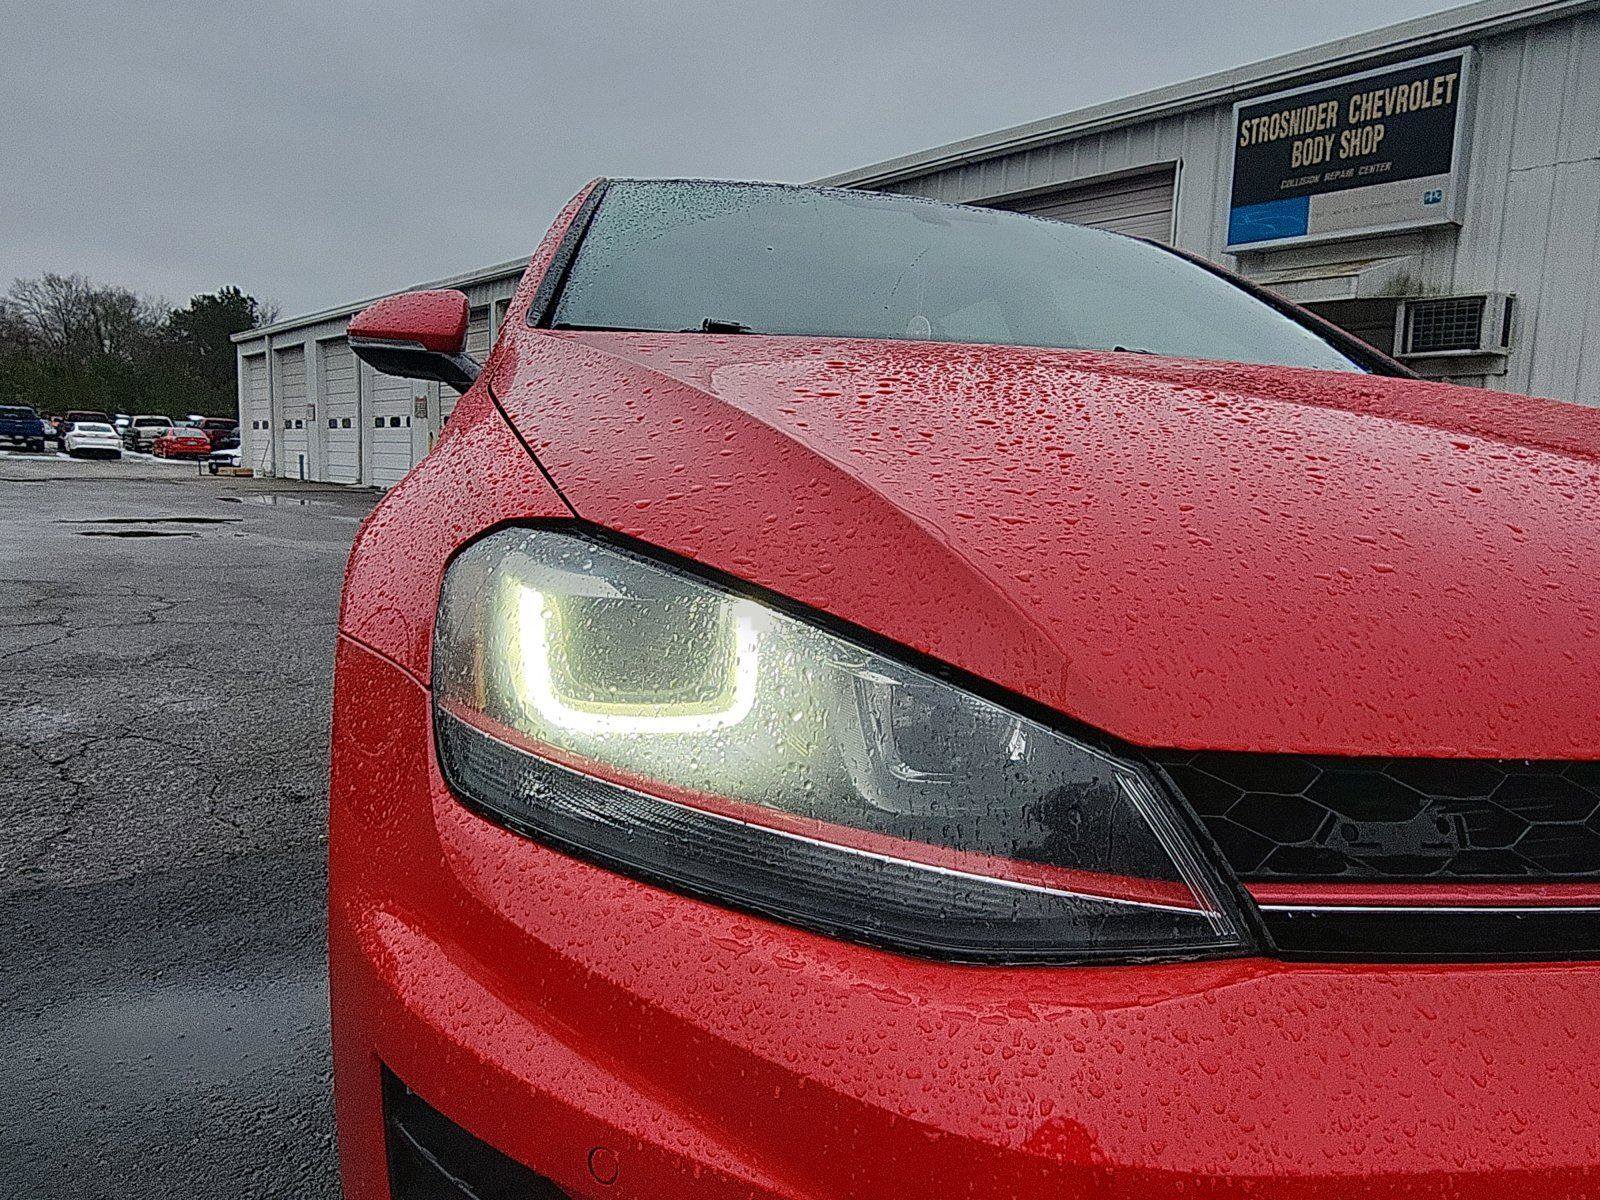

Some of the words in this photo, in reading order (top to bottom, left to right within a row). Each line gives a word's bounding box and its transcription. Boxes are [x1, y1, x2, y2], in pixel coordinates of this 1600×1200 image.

[1240, 101, 1339, 147] STROSNIDER
[1349, 73, 1457, 124] CHEVROLET
[1291, 134, 1335, 168] BODY
[1339, 124, 1385, 159] SHOP
[1325, 168, 1354, 182] REPAIR
[1358, 162, 1392, 176] CENTER
